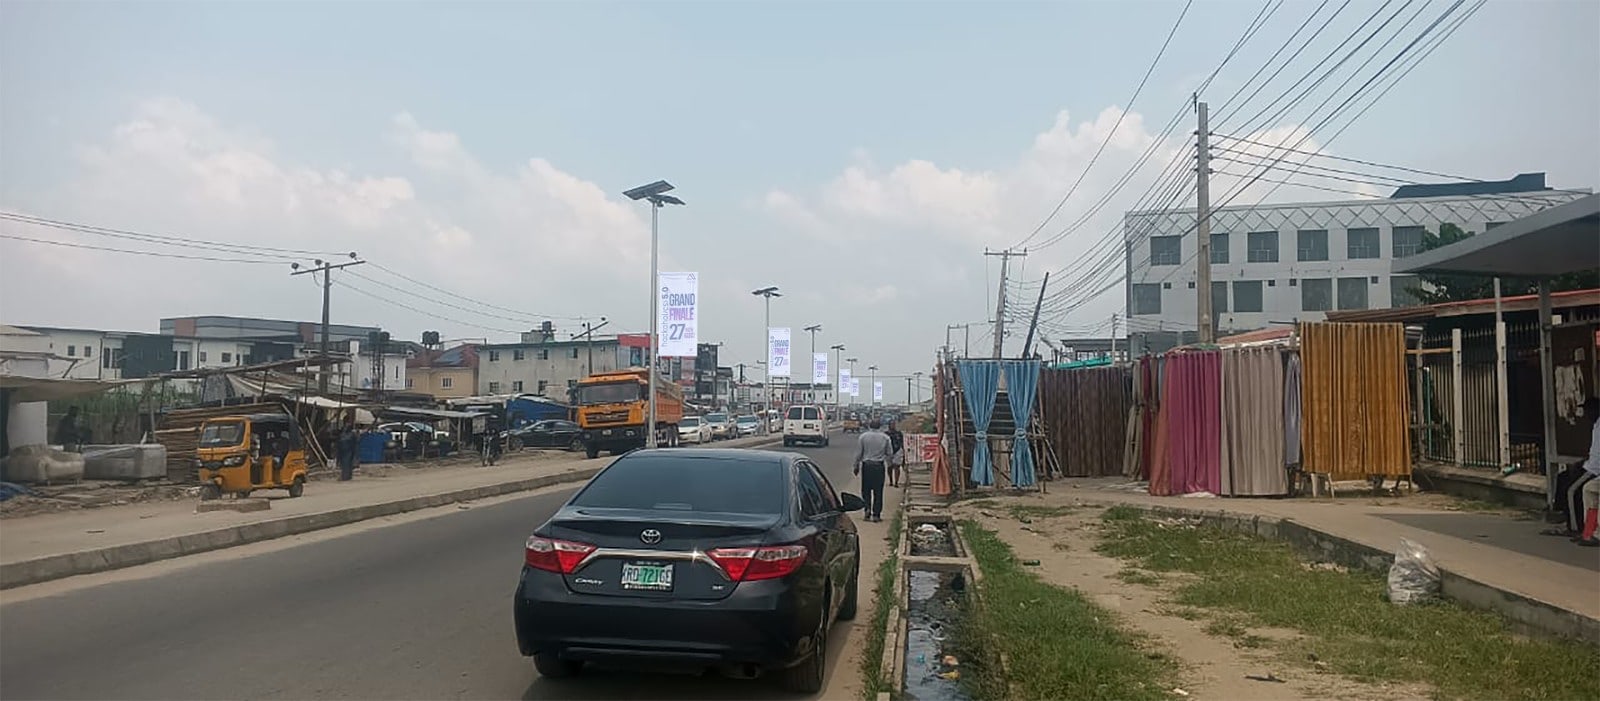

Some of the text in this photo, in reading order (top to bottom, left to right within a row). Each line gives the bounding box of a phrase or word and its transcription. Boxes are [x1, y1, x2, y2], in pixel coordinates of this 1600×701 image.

[669, 294, 695, 306] GRAND
[669, 308, 695, 320] FINALE
[669, 324, 685, 340] 27
[774, 357, 783, 366] 27
